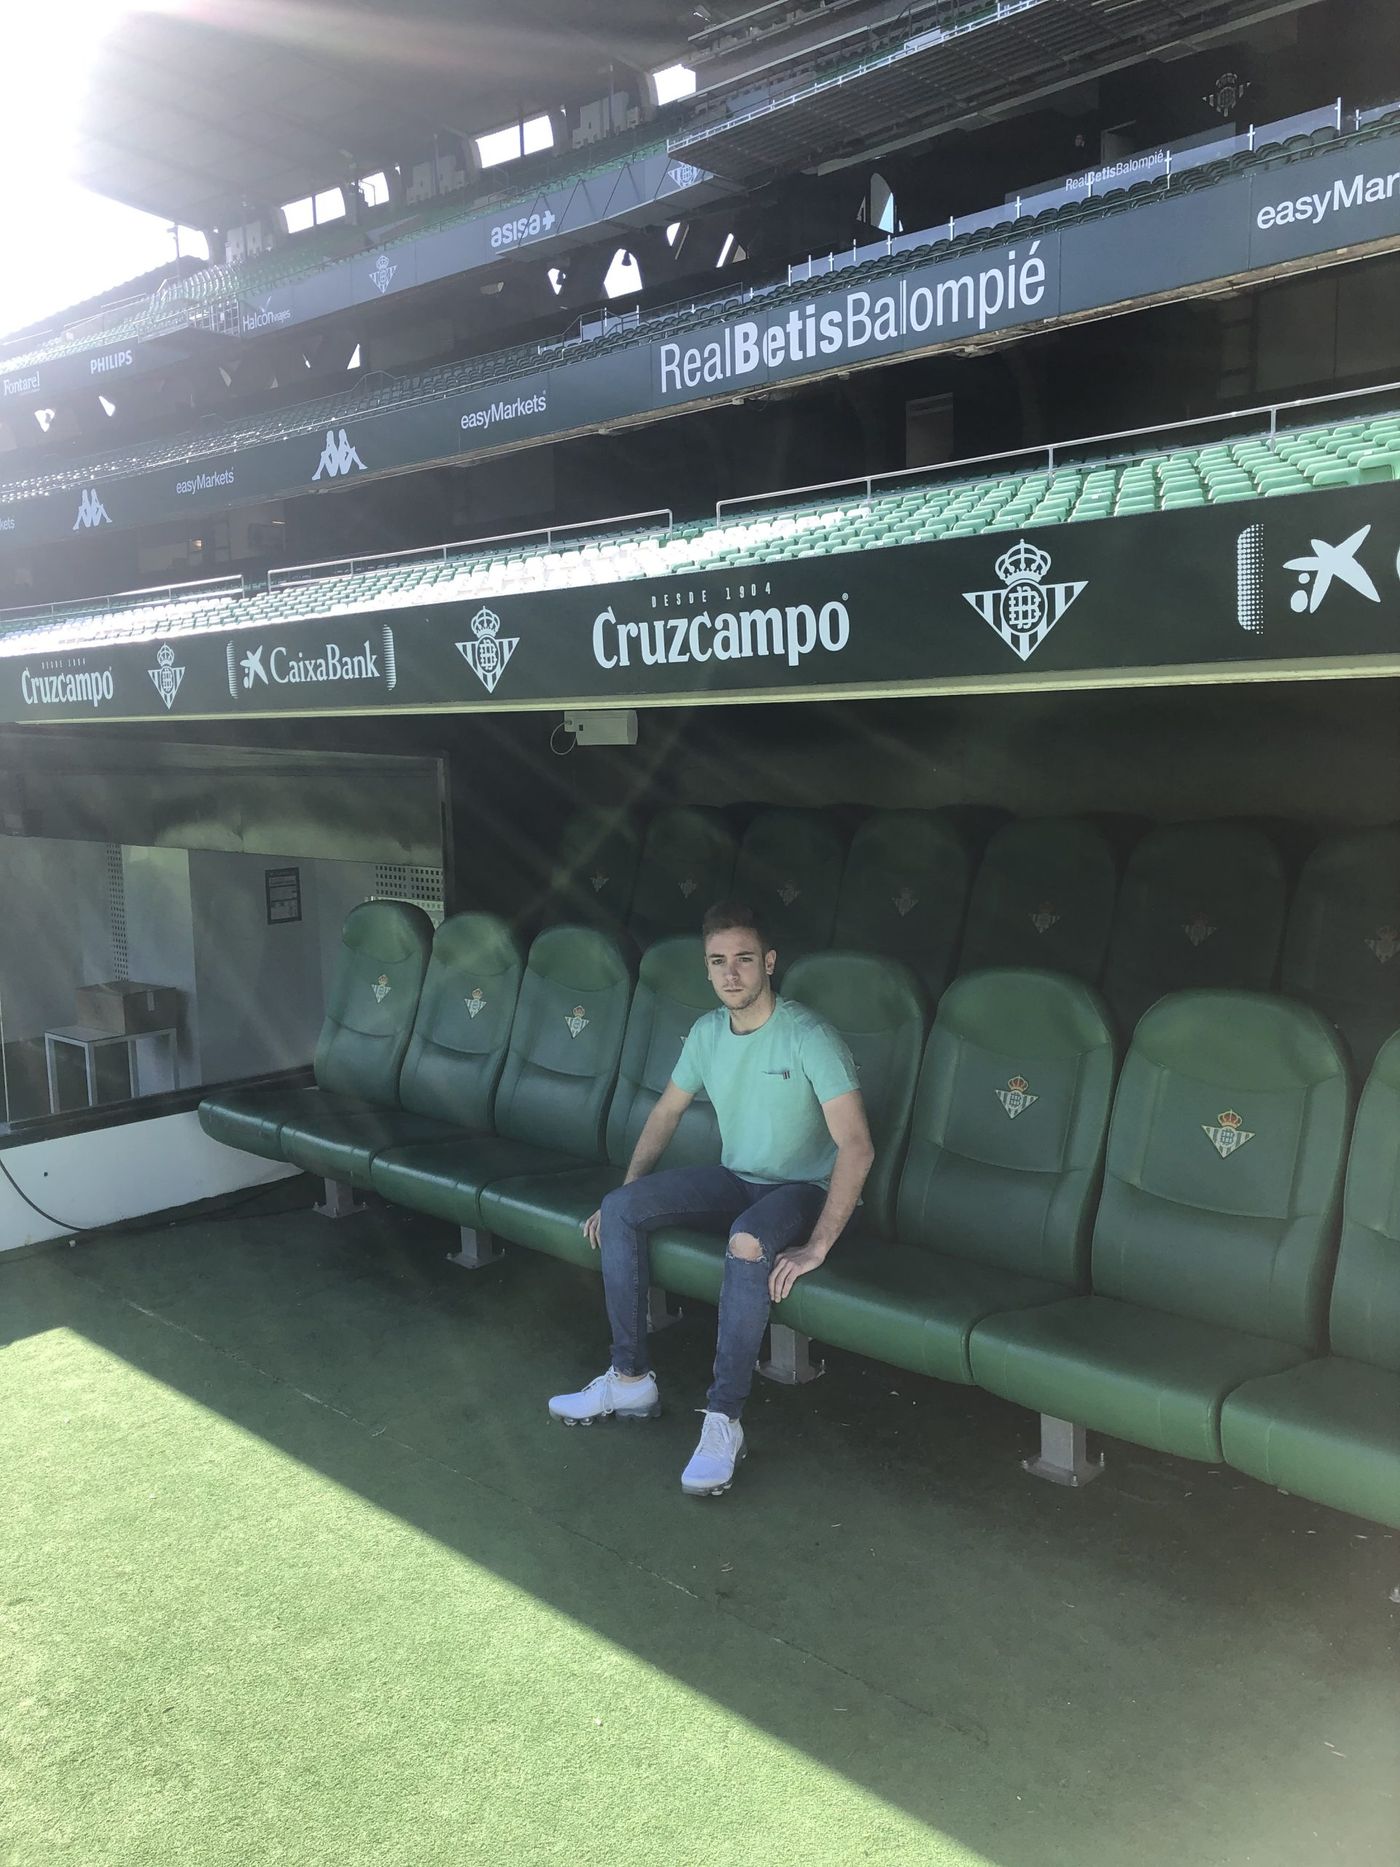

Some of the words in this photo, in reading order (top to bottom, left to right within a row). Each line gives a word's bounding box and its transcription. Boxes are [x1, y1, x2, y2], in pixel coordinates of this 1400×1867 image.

[90, 350, 133, 374] PHILIPS
[3, 371, 40, 396] Fontarel
[460, 394, 547, 430] easyMarkets
[176, 469, 235, 495] easyMarkets
[651, 590, 707, 608] DESDE
[725, 581, 771, 600] 1904
[269, 639, 381, 684] CaixaBank
